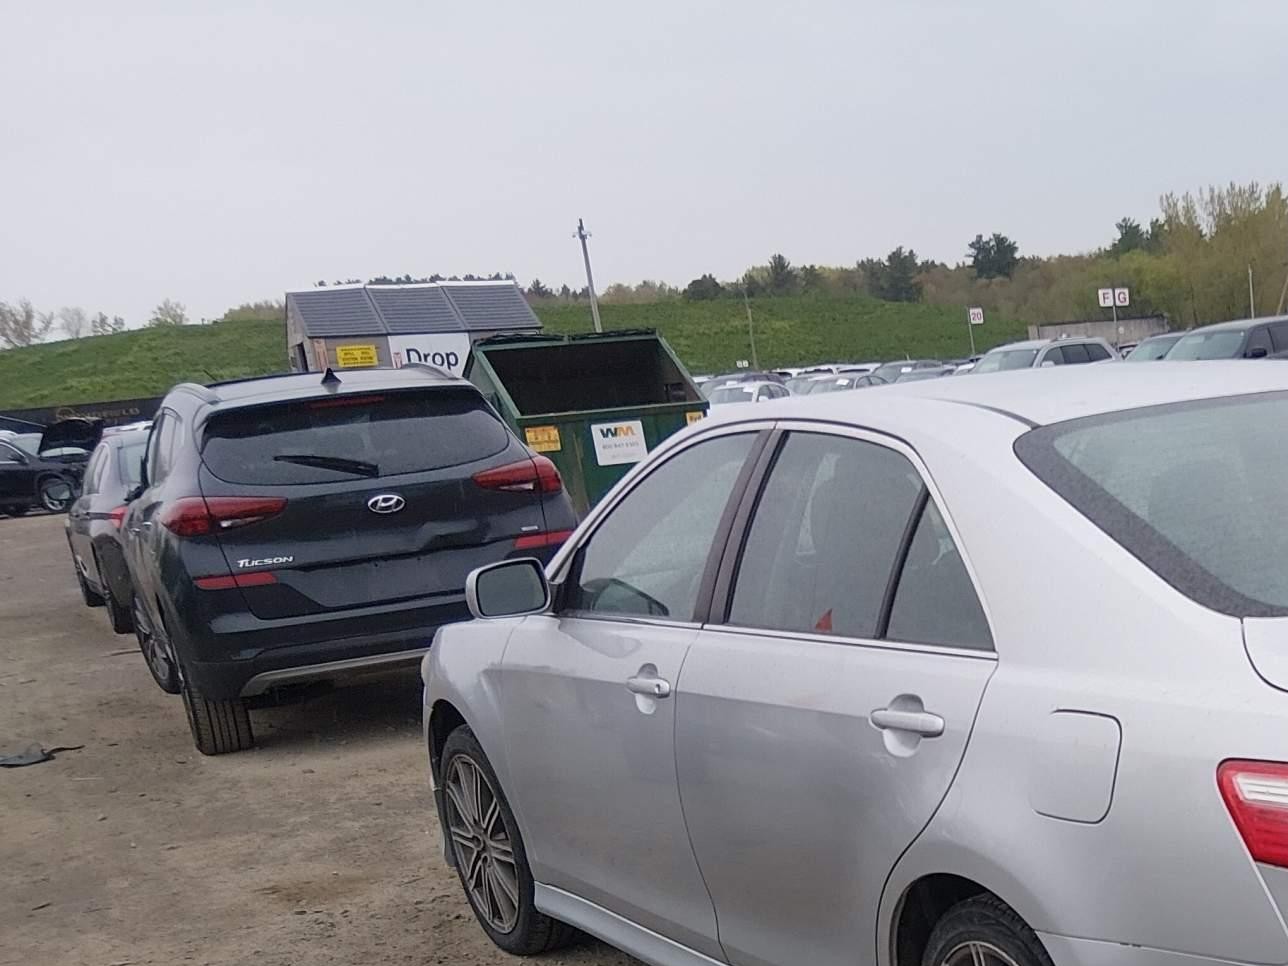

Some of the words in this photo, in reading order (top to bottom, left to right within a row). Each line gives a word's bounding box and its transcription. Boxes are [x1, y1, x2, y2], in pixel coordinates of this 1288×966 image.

[1102, 292, 1110, 304] F
[1117, 291, 1127, 304] G
[970, 312, 982, 321] 20
[406, 348, 459, 370] Drop
[600, 426, 636, 438] WM
[237, 556, 293, 567] TUCSON
